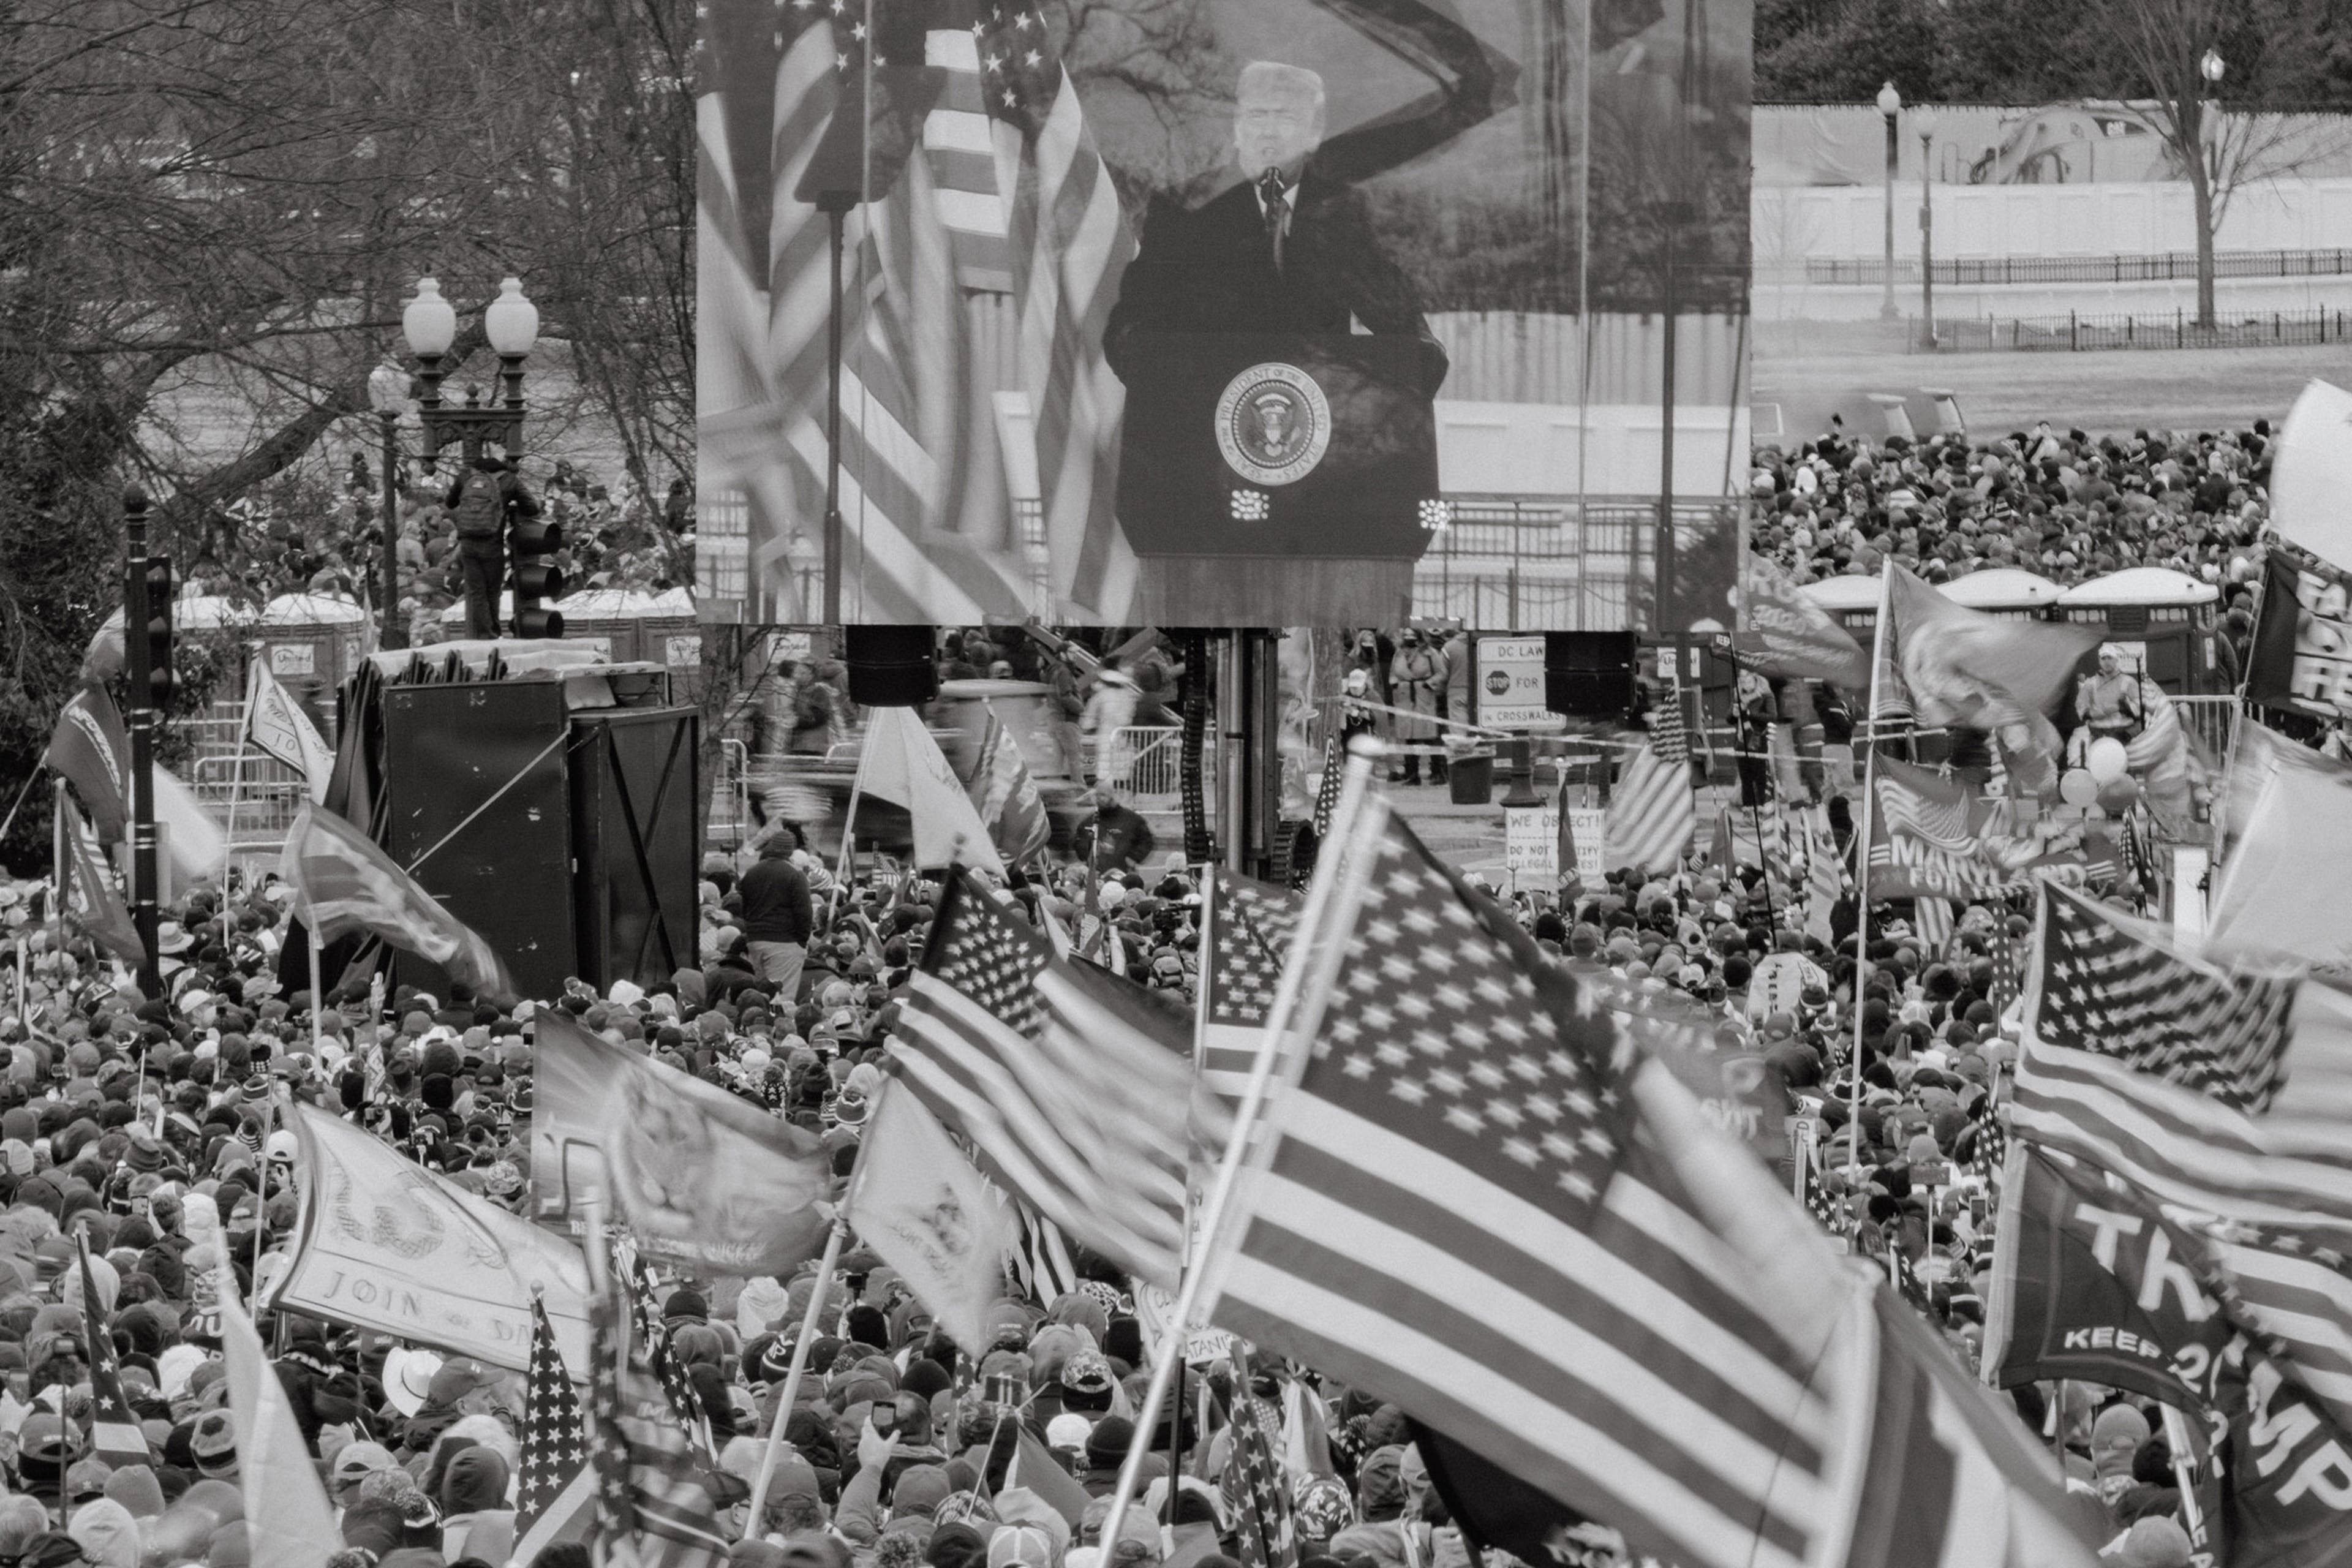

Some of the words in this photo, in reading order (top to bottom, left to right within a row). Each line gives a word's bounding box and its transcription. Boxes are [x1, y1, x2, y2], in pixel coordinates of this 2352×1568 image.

[1498, 646, 1513, 656] DC
[1519, 645, 1544, 657] LAW
[1485, 677, 1510, 690] STOP
[1516, 678, 1539, 688] FOR
[1497, 710, 1561, 722] CROSSWALKS
[1510, 815, 1532, 827] WE
[1542, 815, 1599, 827] OBECT!
[1510, 845, 1523, 855] DO
[1530, 845, 1550, 855] NOT
[323, 1271, 421, 1317] JOIN
[2064, 1326, 2162, 1359] KEEP
